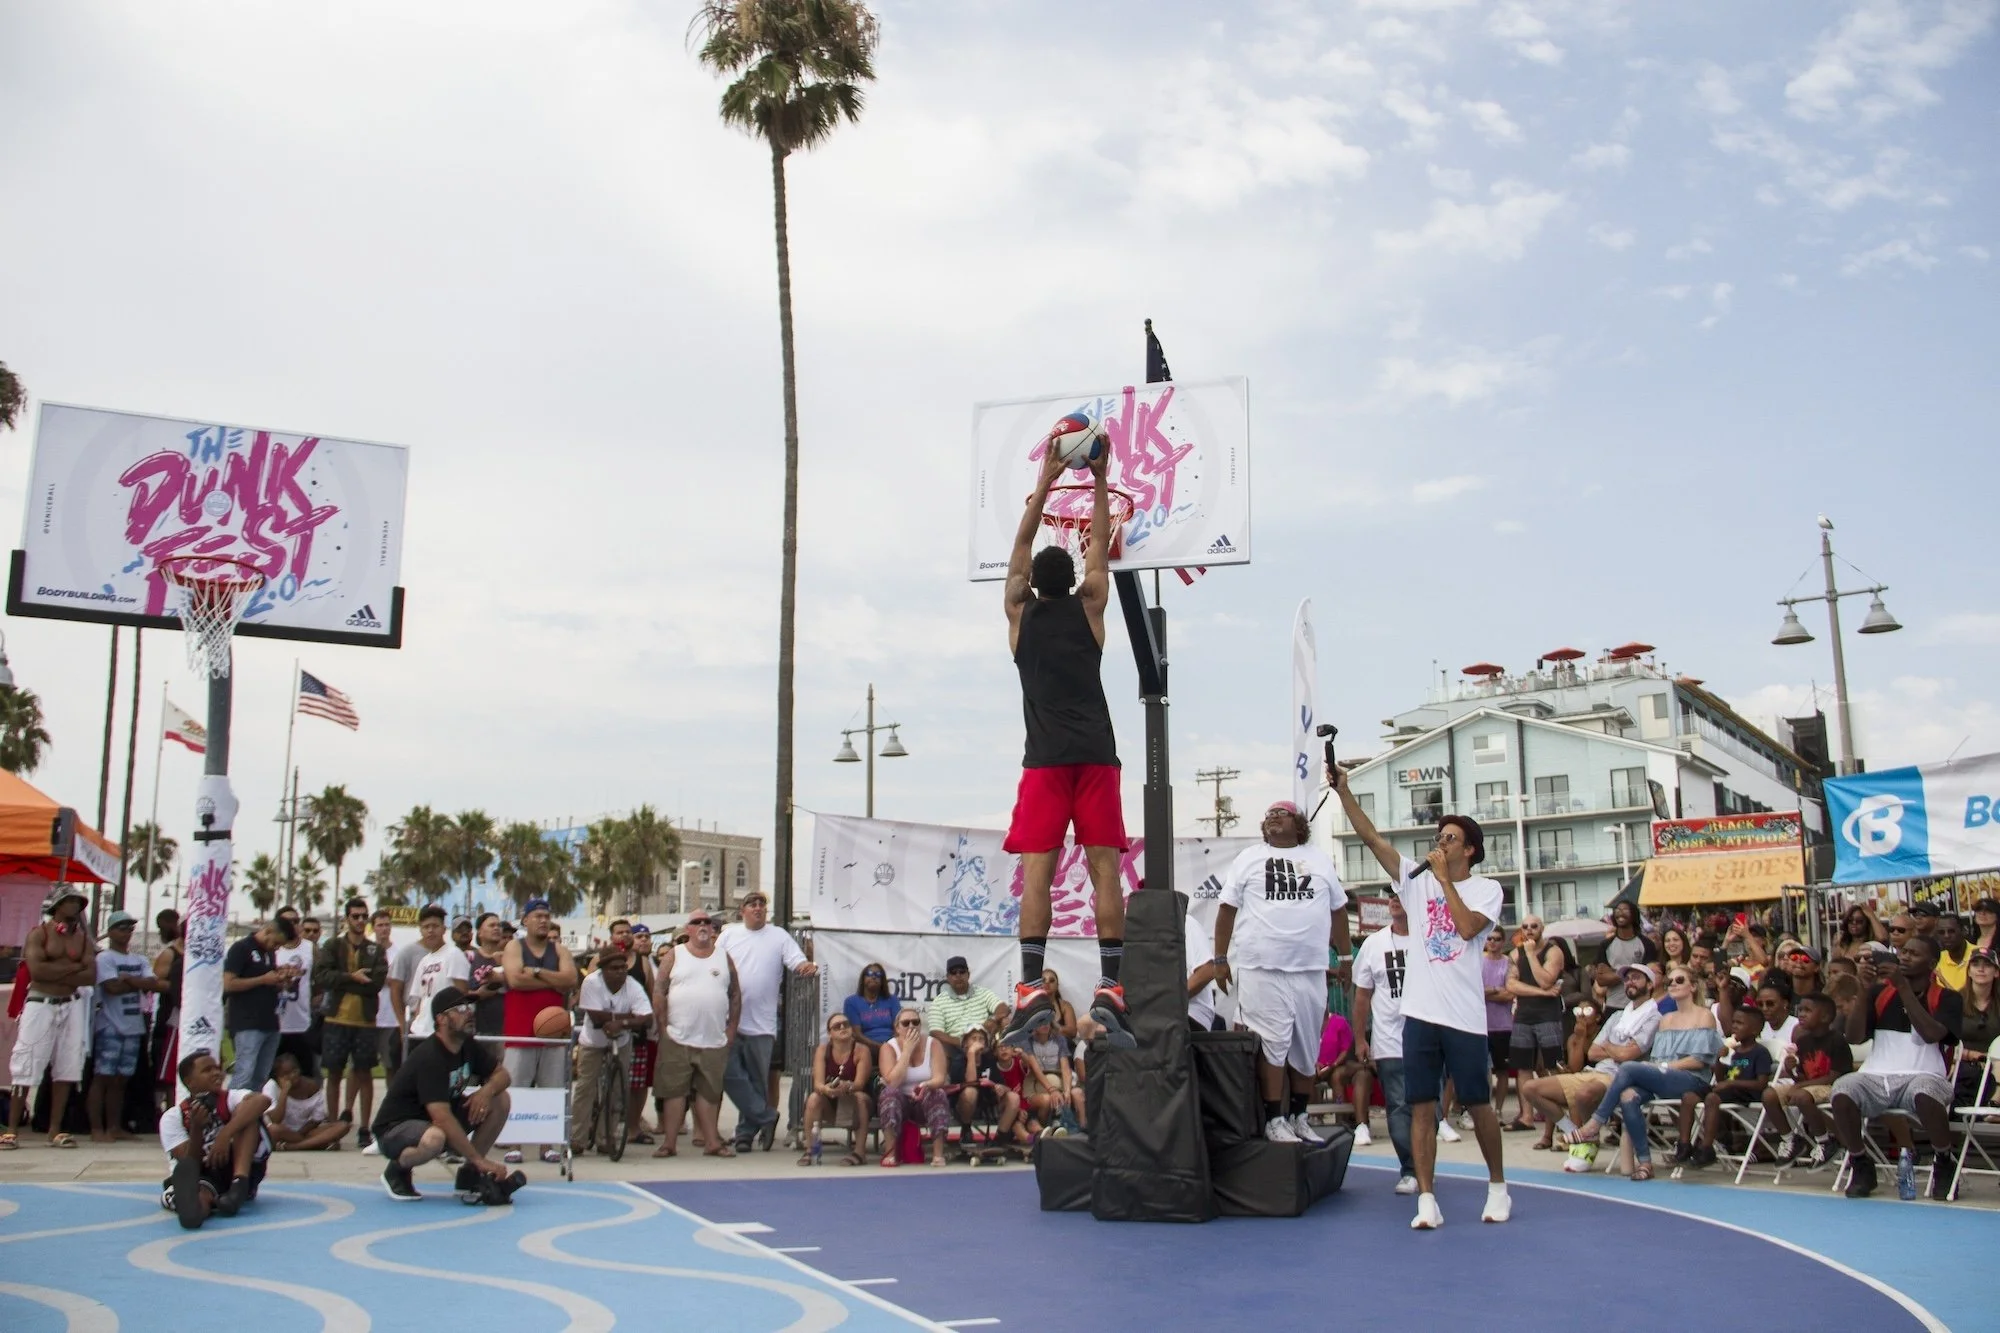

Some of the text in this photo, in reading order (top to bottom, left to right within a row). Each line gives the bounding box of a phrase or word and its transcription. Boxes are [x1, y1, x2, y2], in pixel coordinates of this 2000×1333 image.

[185, 426, 245, 464] THE
[118, 430, 320, 545] DUNK
[43, 482, 56, 535] @VENICEBALL
[1125, 503, 1167, 547] 2.0
[1207, 546, 1237, 555] adidas
[345, 618, 382, 629] adidas
[1708, 819, 1756, 833] BLACK
[1667, 832, 1789, 852] ROSE TATTOOS
[818, 846, 827, 896] @VENICEBALL
[1714, 856, 1799, 880] SHOES
[1265, 891, 1315, 901] HOOPS
